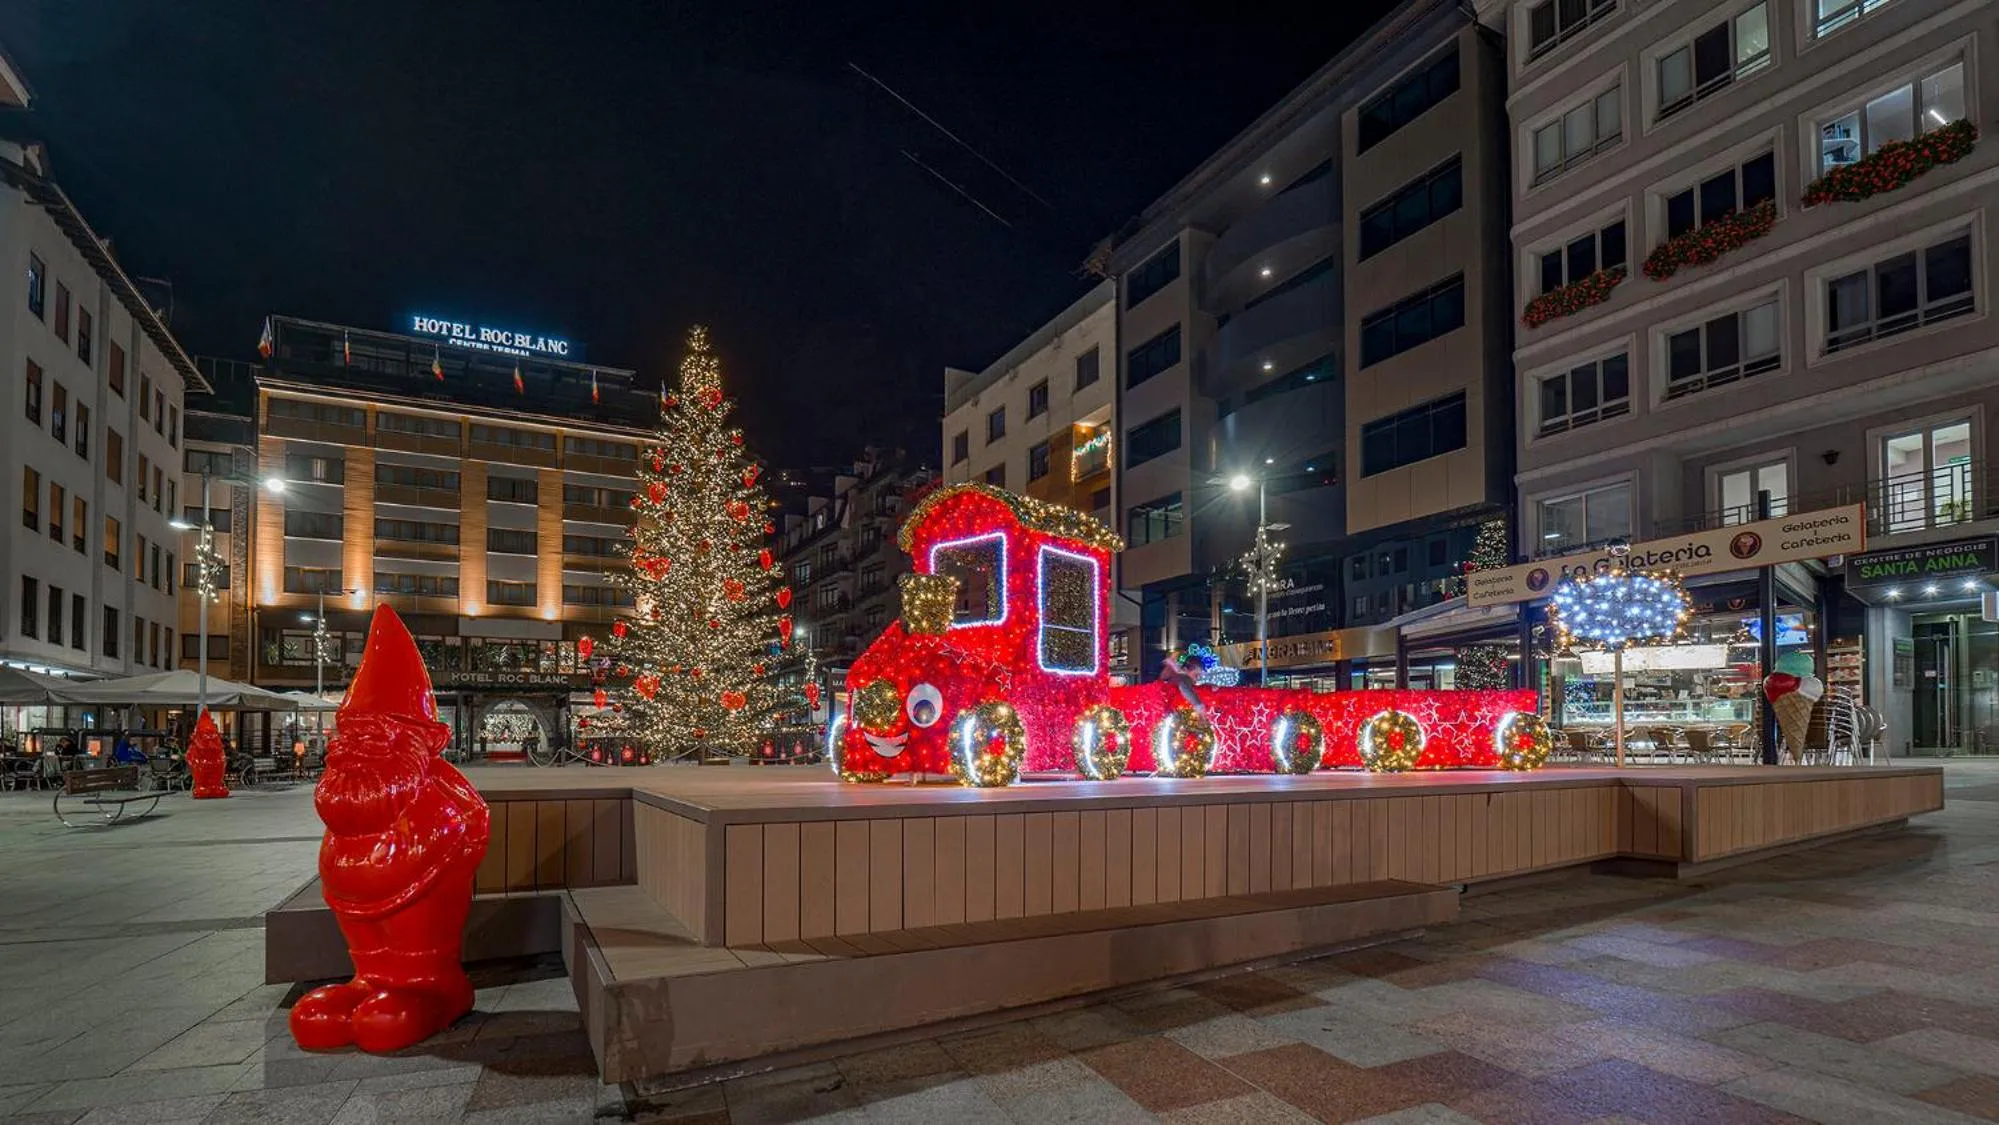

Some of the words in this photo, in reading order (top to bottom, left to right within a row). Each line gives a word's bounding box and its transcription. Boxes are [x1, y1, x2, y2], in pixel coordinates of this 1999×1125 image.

[413, 316, 476, 340] HOTEL
[480, 327, 513, 345] ROC
[514, 333, 569, 355] BLANC
[450, 338, 489, 350] CENTRE
[1781, 515, 1849, 533] Gelateria
[1780, 533, 1851, 550] Cafeteria
[1593, 542, 1711, 575] Glateria
[1854, 555, 1901, 566] CENTRE
[1905, 551, 1922, 559] DE
[1926, 543, 1988, 557] NEGOCIS
[1860, 560, 1919, 578] SANTA
[1924, 553, 1979, 571] ANNA
[451, 672, 493, 682] HOTEL
[498, 673, 524, 684] ROC
[529, 675, 569, 685] BLANC
